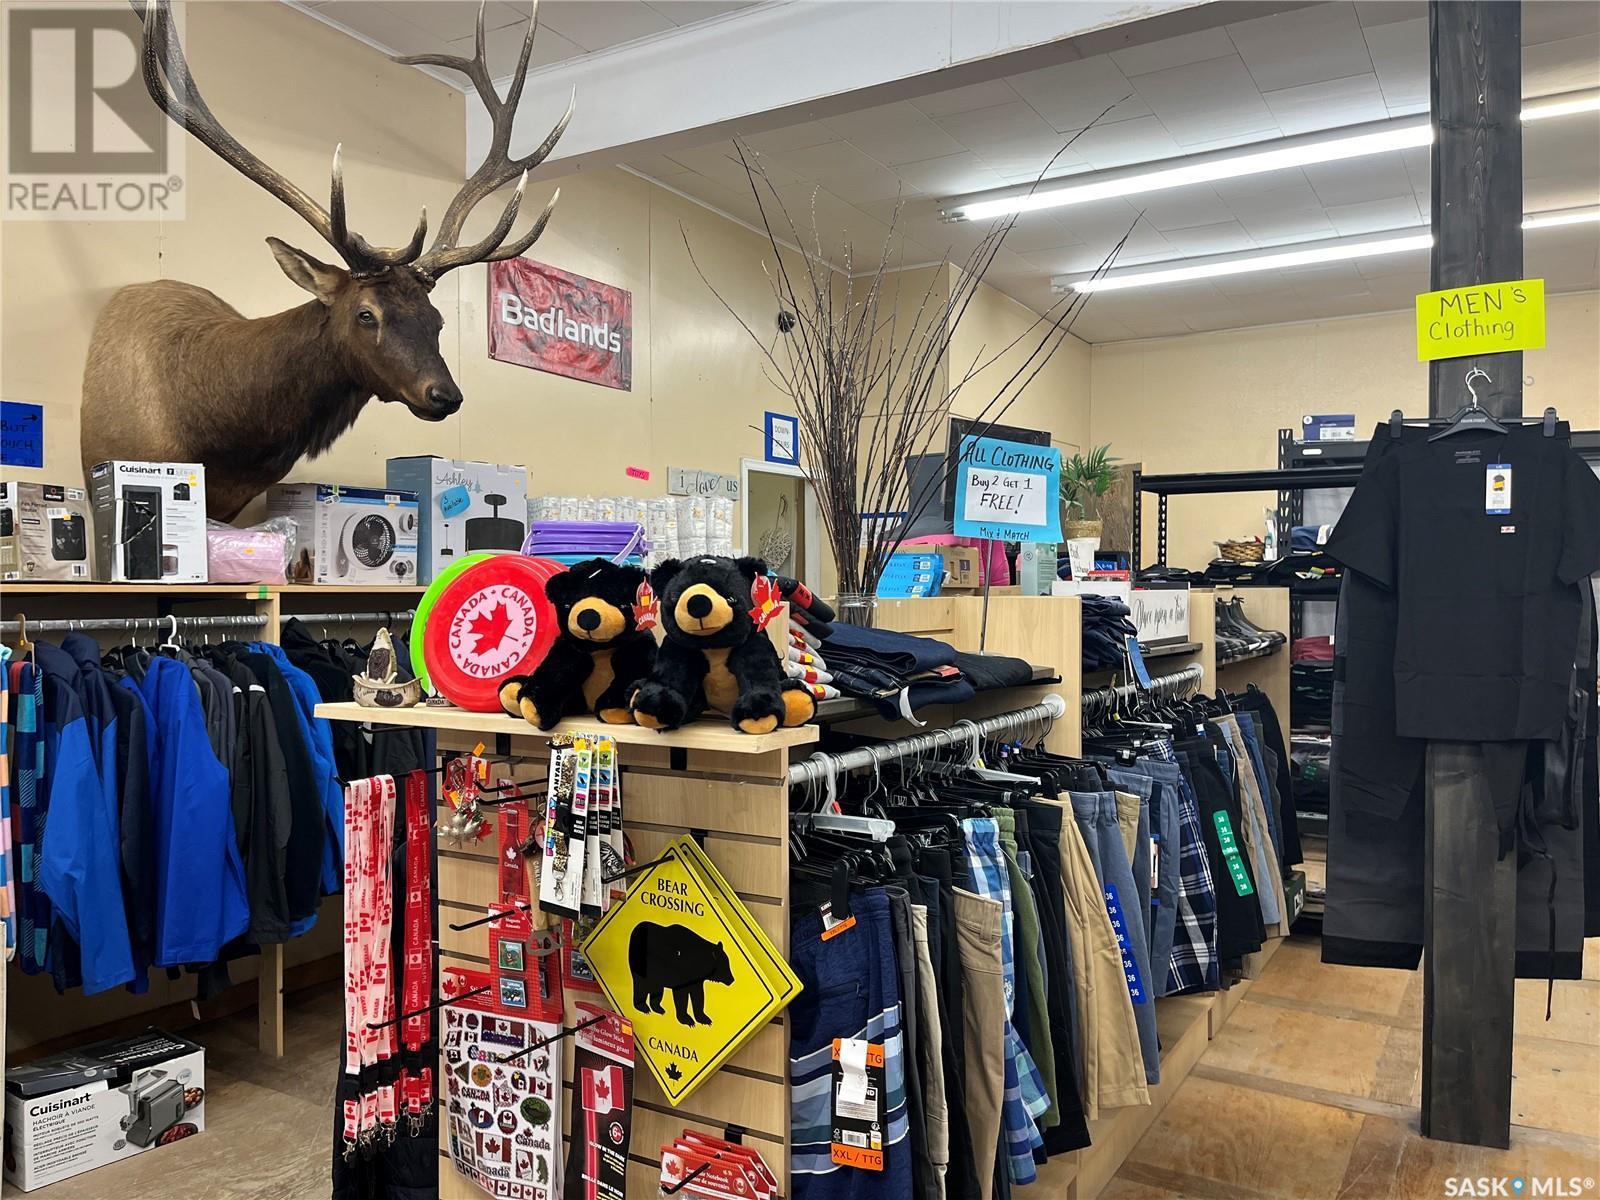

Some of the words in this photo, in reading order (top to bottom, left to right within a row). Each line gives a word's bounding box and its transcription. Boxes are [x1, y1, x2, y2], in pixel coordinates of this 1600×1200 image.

[501, 291, 621, 353] Badlands
[1429, 318, 1515, 341] Clothing
[991, 446, 1055, 472] CLOTHING
[119, 465, 162, 474] Cuisinart
[435, 472, 473, 492] Ashley
[680, 470, 684, 488] i
[686, 471, 723, 495] love
[726, 480, 738, 492] us
[971, 474, 990, 491] Buy
[992, 475, 999, 486] 2
[1023, 478, 1033, 490] 1
[980, 493, 1024, 515] FREE!
[451, 591, 488, 649] CANADA
[501, 587, 535, 637] CANADA
[462, 651, 520, 676] CANADA
[503, 861, 519, 870] Canada
[657, 878, 688, 896] BEAR
[1105, 892, 1114, 900] 36
[640, 891, 705, 917] CROSSING
[1108, 906, 1117, 914] 36
[1112, 920, 1120, 928] 36
[1123, 960, 1132, 968] 36
[1127, 974, 1136, 982] 36
[1131, 988, 1140, 997] 36
[648, 1036, 699, 1062] CANADA
[30, 1092, 92, 1117] Cuisinart
[71, 1104, 95, 1115] VIANDE
[515, 1133, 551, 1152] Canada
[833, 1148, 852, 1161] XXL
[854, 1152, 860, 1161] /
[862, 1154, 882, 1165] TTG
